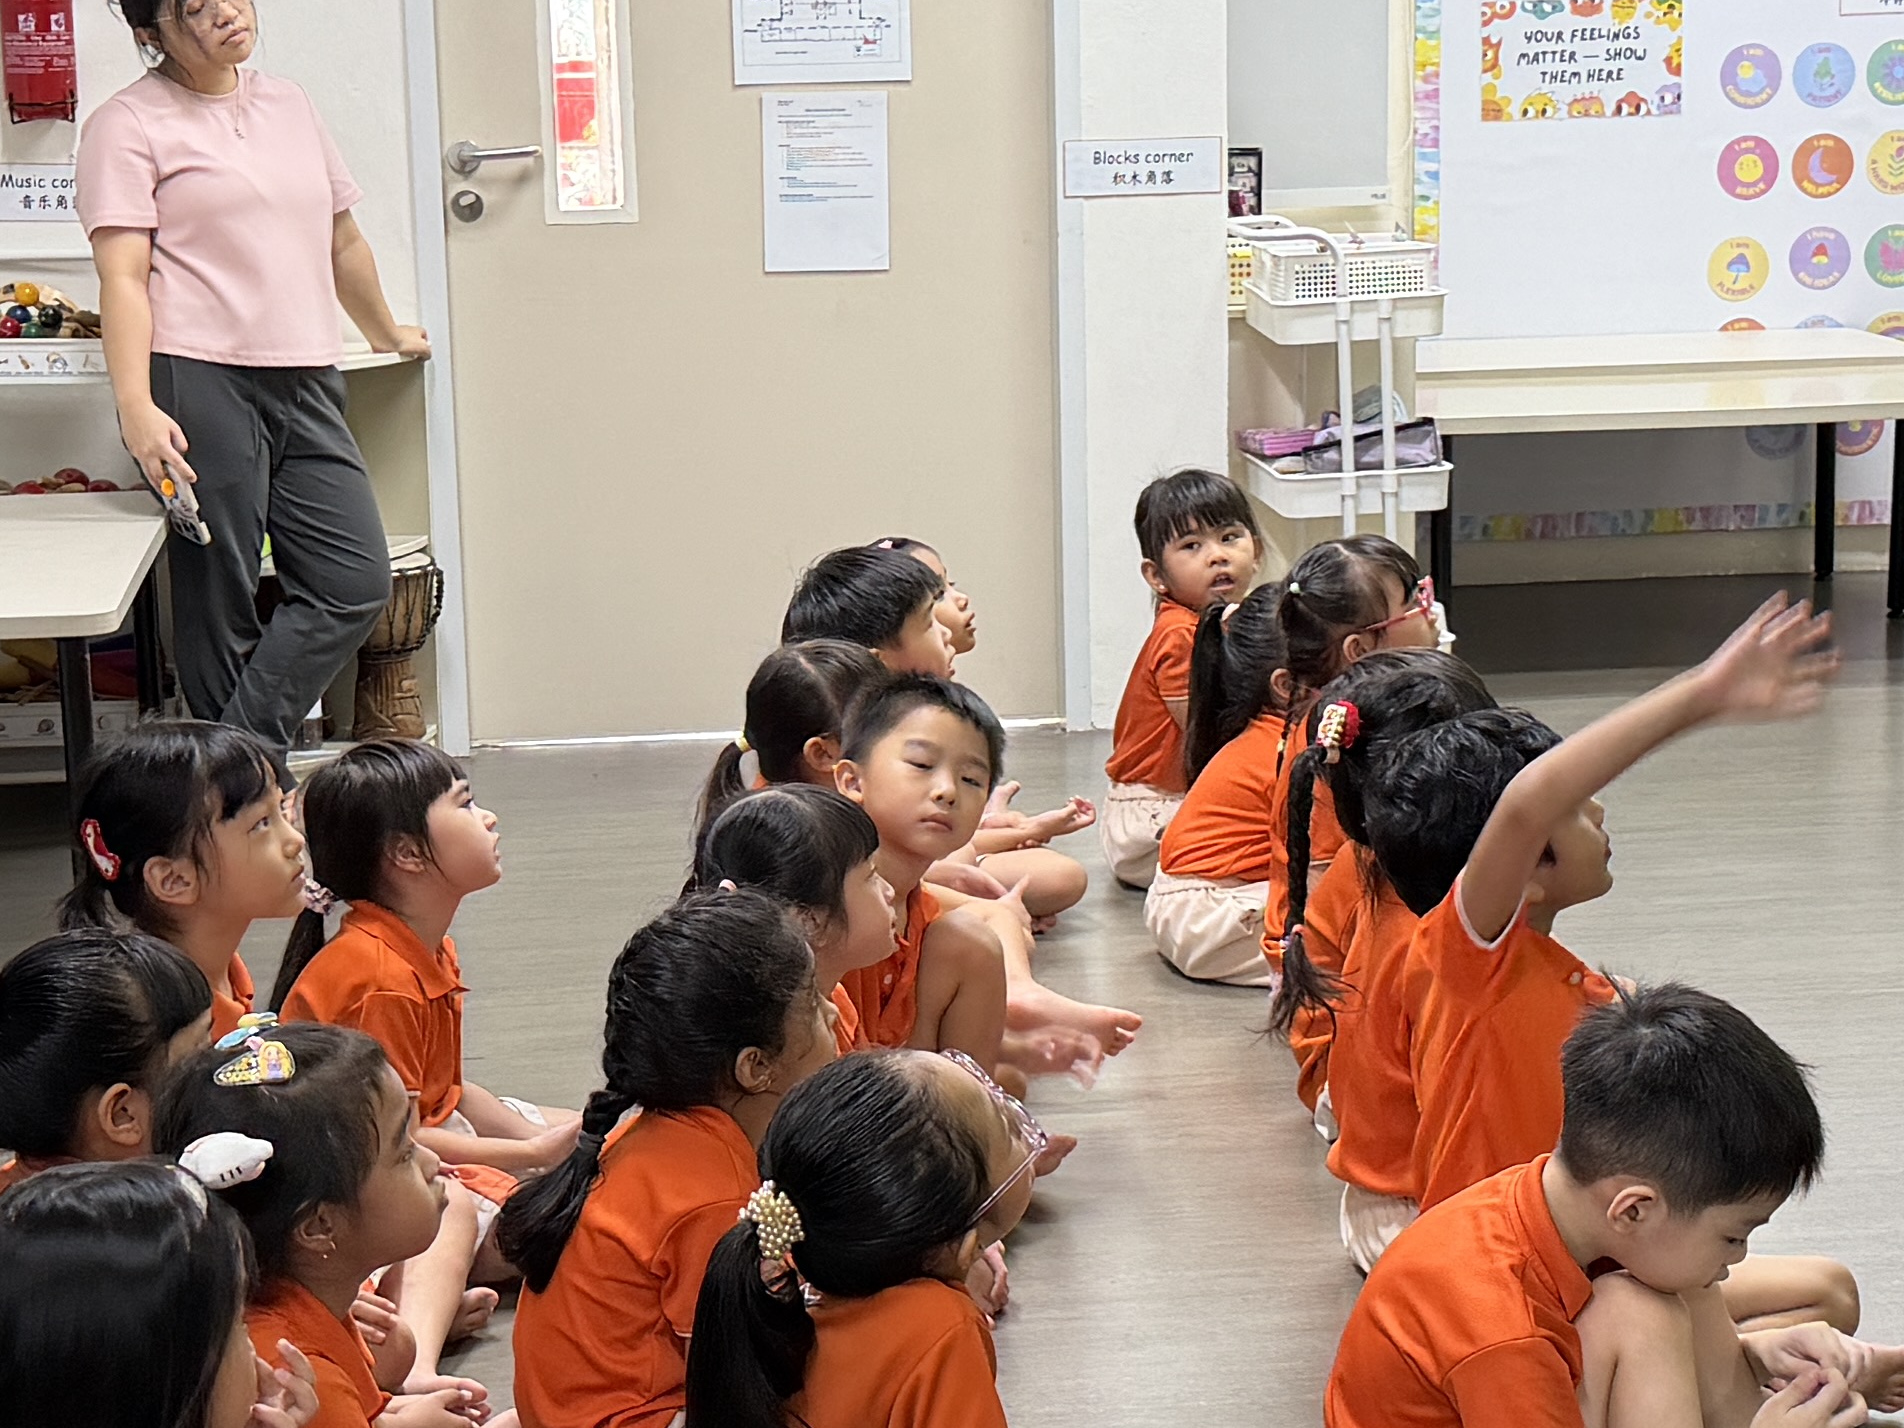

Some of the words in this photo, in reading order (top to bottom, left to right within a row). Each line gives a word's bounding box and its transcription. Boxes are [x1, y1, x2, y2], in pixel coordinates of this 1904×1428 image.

[1523, 28, 1566, 45] YOUR
[1570, 25, 1641, 44] FEELINGS
[1516, 48, 1578, 66] MATTER
[1604, 46, 1647, 63] SHOW
[1540, 68, 1582, 85] THEM
[1586, 66, 1625, 83] HERE
[1093, 150, 1140, 165] Blocks
[1145, 151, 1194, 164] corner
[0, 174, 46, 188] Music
[51, 178, 75, 189] cor
[1111, 170, 1175, 186] 积木角落
[19, 195, 77, 210] 音乐角
